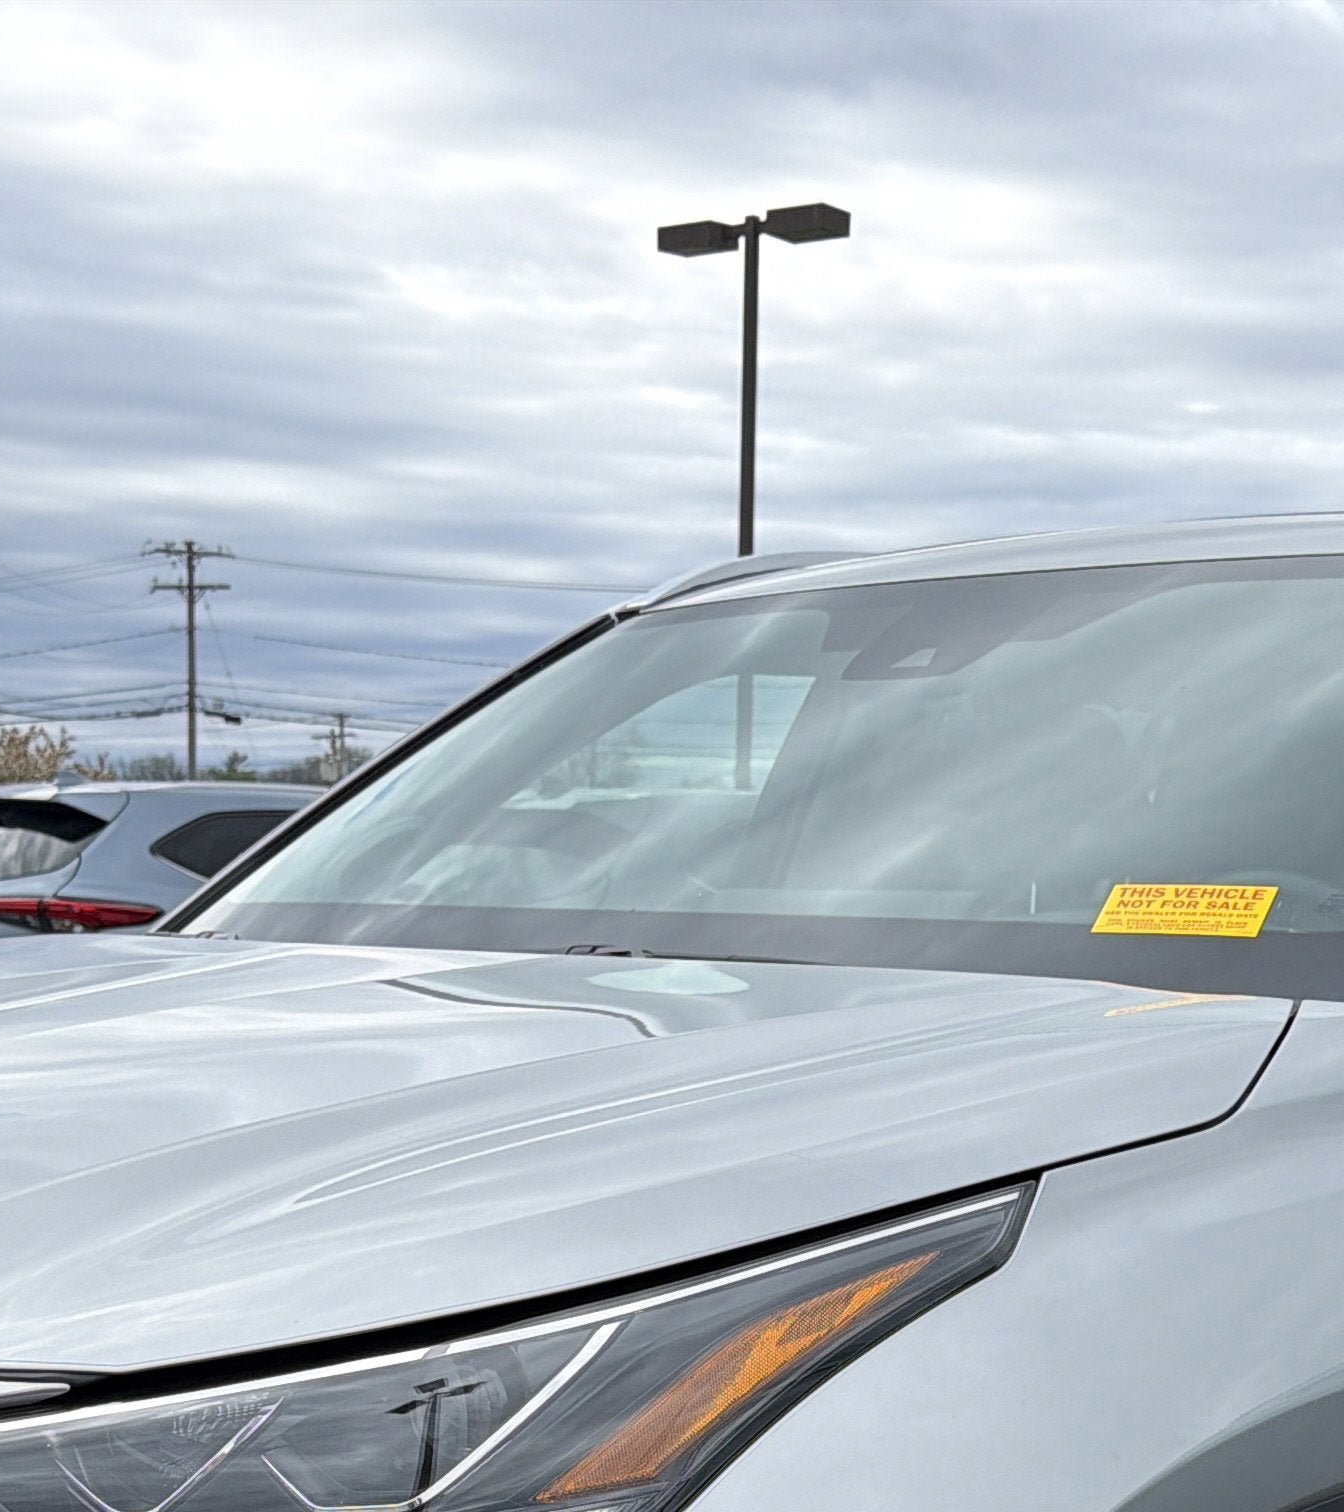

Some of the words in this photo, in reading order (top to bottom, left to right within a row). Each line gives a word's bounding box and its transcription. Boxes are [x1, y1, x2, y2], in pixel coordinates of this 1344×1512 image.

[1119, 887, 1166, 899] THIS
[1173, 888, 1268, 900] VEHICLE
[1116, 900, 1155, 909] NOT
[1160, 900, 1199, 911] FOR
[1205, 901, 1257, 911] SALE
